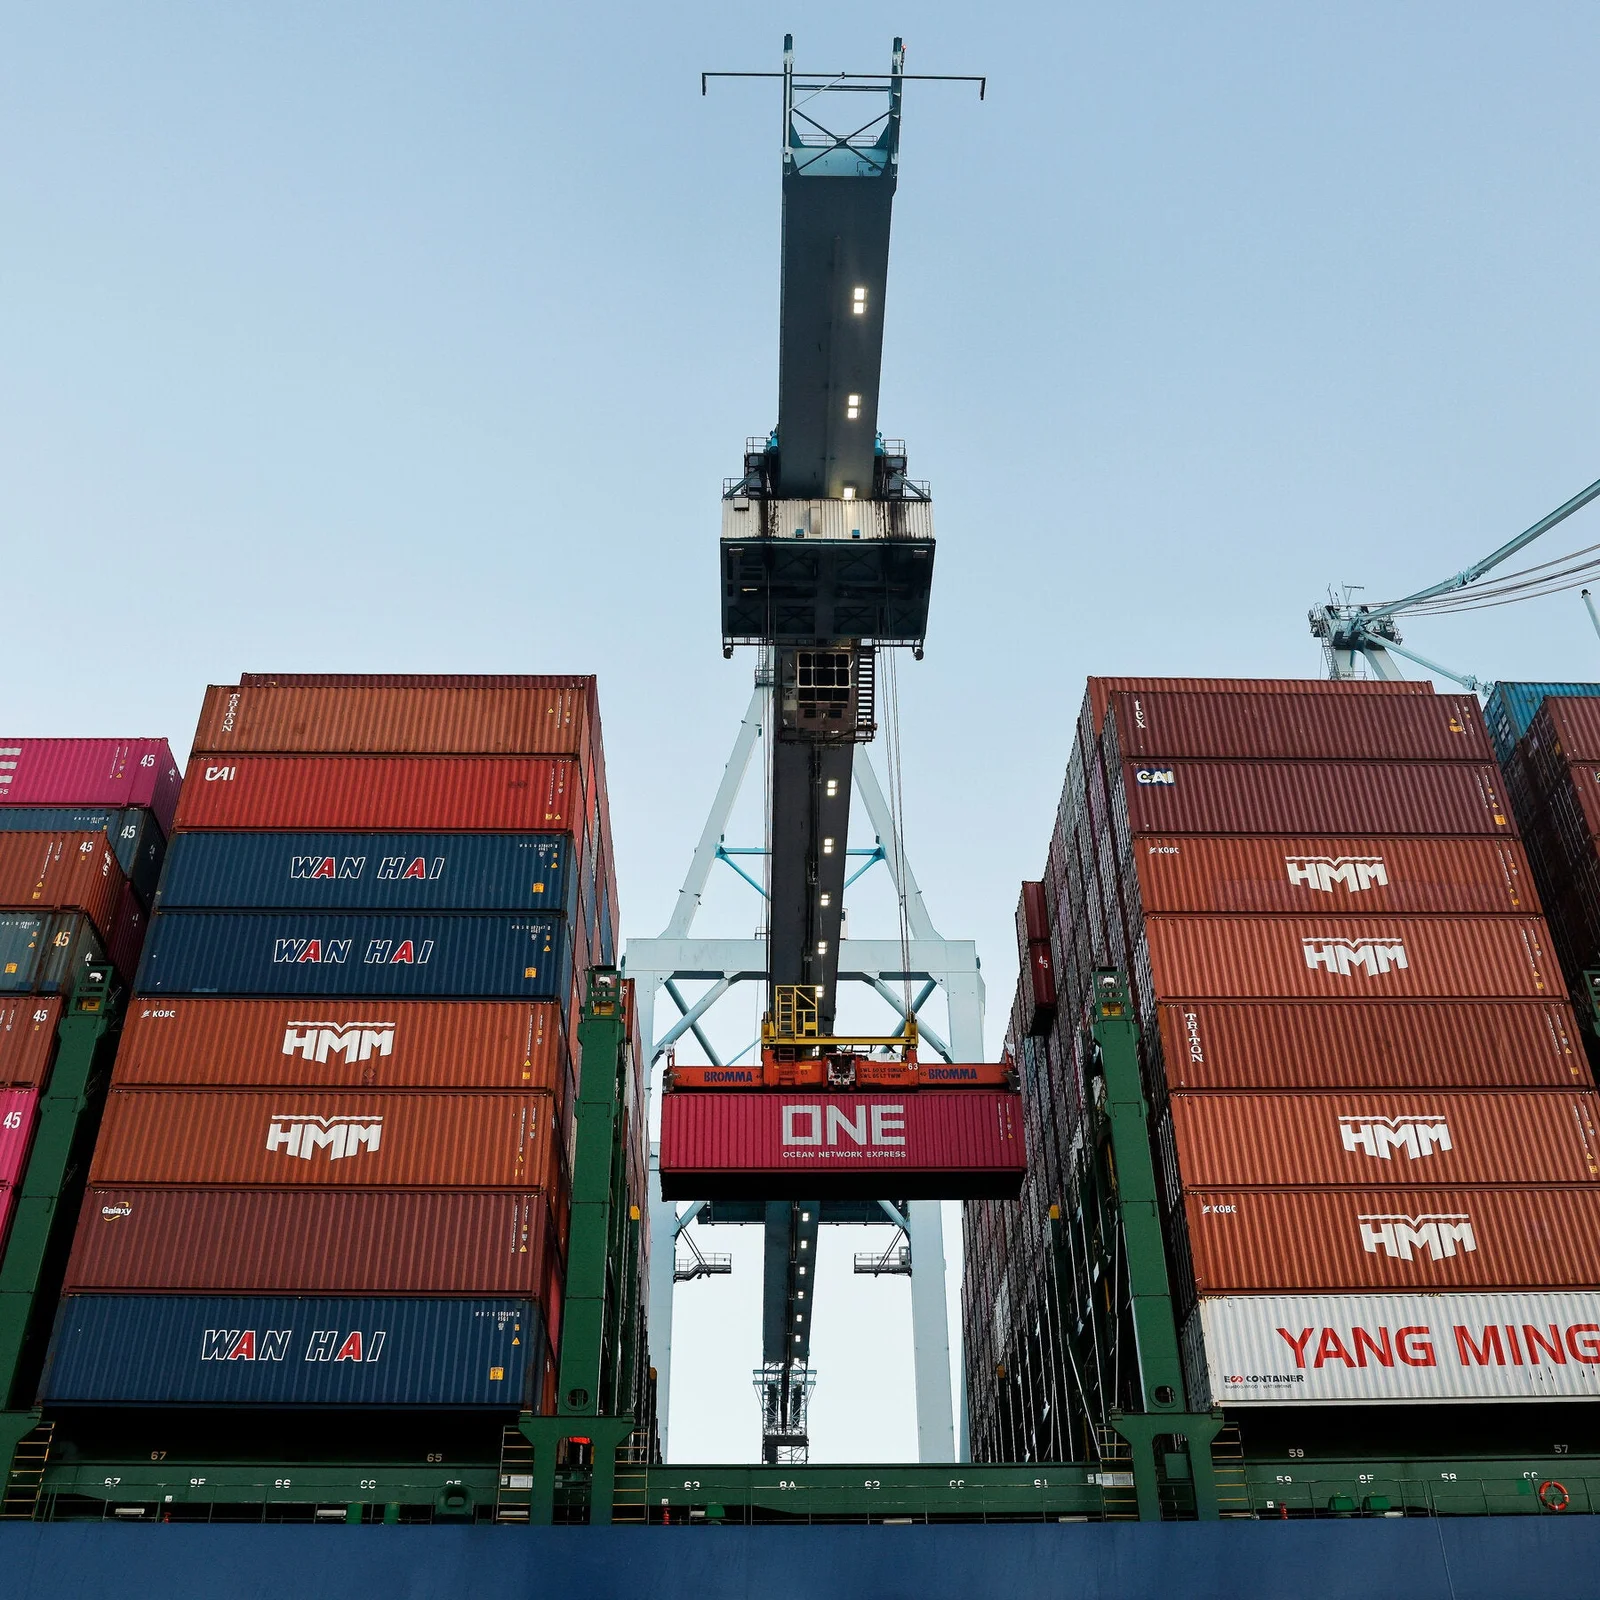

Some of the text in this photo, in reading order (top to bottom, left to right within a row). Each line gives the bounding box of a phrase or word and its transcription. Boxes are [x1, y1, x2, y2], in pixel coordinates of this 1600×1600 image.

[221, 693, 240, 732] TRITON
[1134, 700, 1146, 728] tex
[140, 754, 156, 767] 45
[204, 766, 236, 781] CAI
[1136, 771, 1174, 784] CAI
[121, 825, 136, 838] 45
[80, 841, 94, 853] 45
[290, 856, 445, 880] WAN HAI
[1285, 856, 1389, 893] HMM
[53, 931, 71, 947] 45
[273, 939, 434, 964] WAN HAI
[1302, 937, 1409, 977] HMM
[33, 1009, 48, 1022] 45
[152, 1009, 176, 1018] KOBC
[282, 1020, 396, 1064] HMM
[1185, 1013, 1204, 1063] TRITON
[907, 1062, 919, 1071] 63
[928, 1068, 977, 1080] BROMMA
[704, 1071, 753, 1082] BROMMA
[3, 1111, 22, 1129] 45
[782, 1105, 906, 1145] ONE
[265, 1115, 384, 1162] HMM
[1338, 1115, 1453, 1160] HMM
[102, 1205, 132, 1217] Galaxy
[1212, 1205, 1237, 1214] KOBC
[1358, 1214, 1477, 1261] HMM
[201, 1329, 386, 1362] WAN HAI
[1276, 1323, 1600, 1369] YANG MING
[1246, 1374, 1304, 1383] CONTAINER
[150, 1451, 167, 1460] 67
[1288, 1448, 1304, 1458] 59
[1553, 1444, 1569, 1454] 57
[426, 1453, 443, 1462] 65
